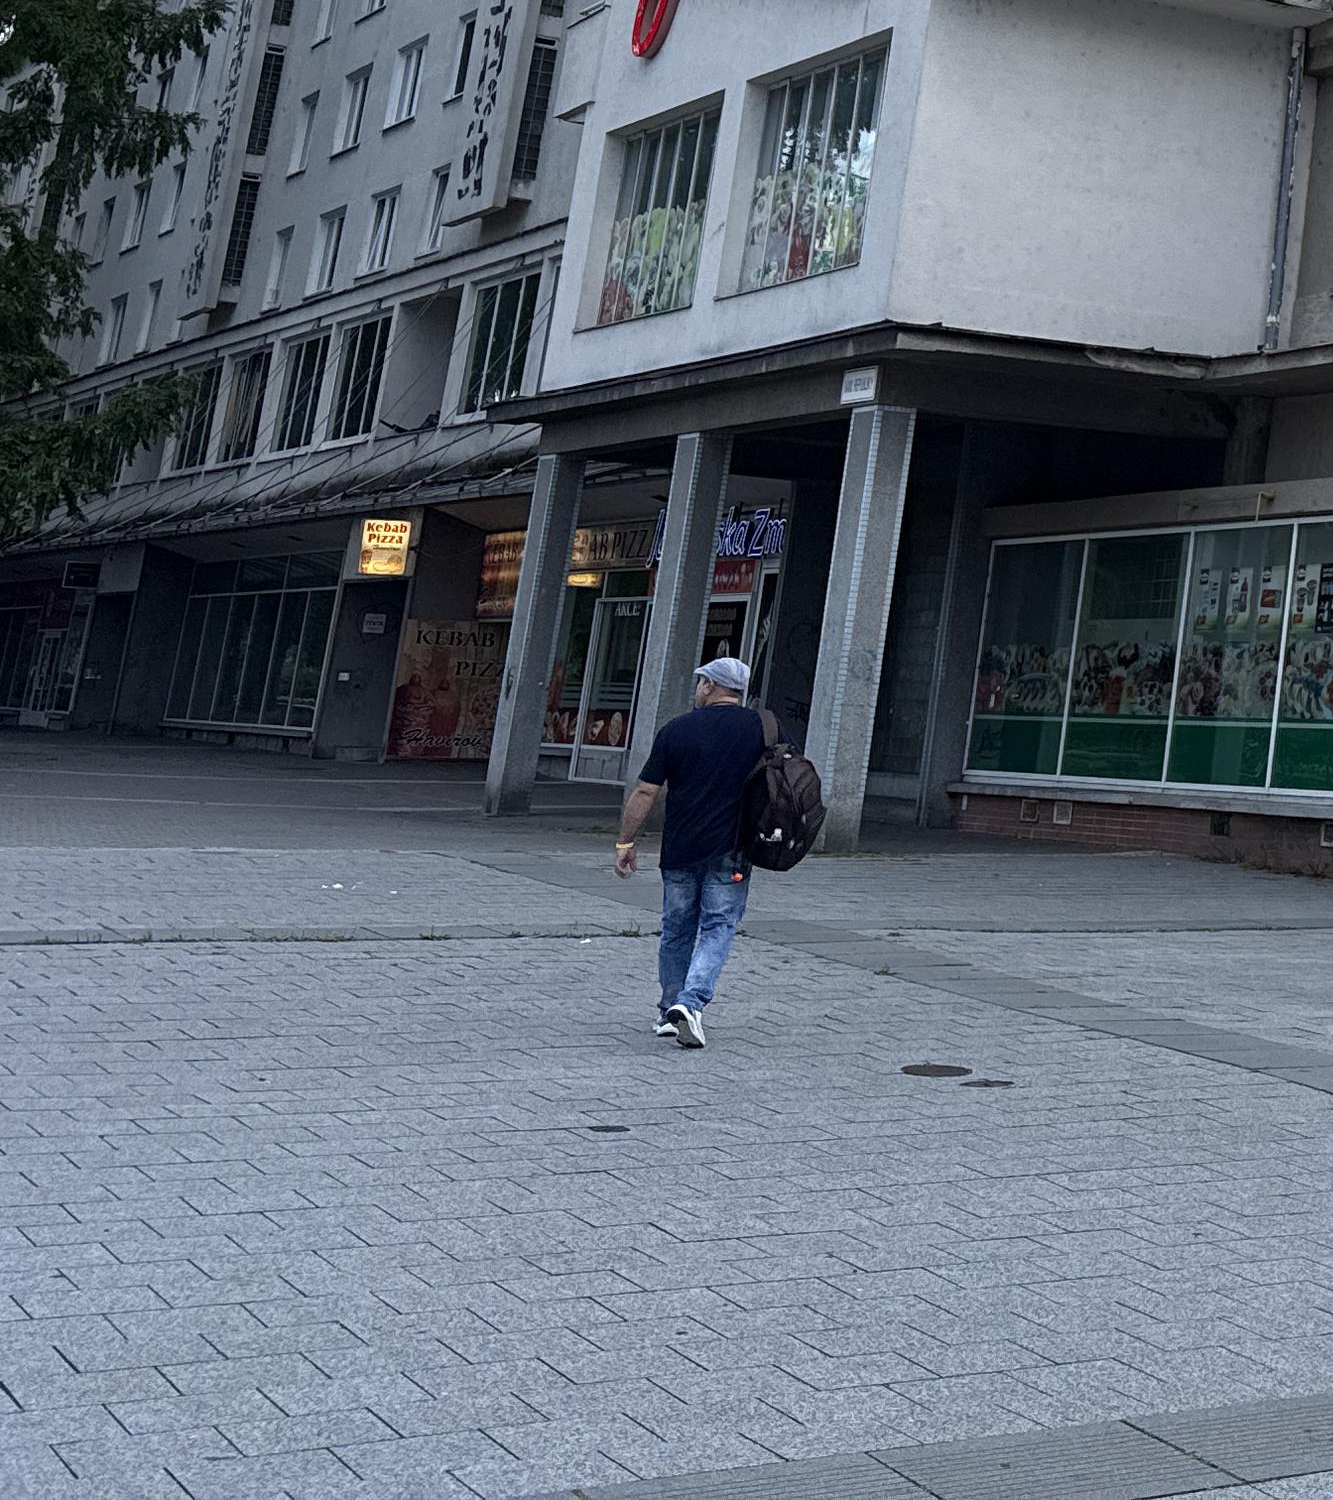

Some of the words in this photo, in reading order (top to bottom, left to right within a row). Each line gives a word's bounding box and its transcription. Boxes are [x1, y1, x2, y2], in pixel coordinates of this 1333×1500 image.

[366, 522, 408, 534] Kebab
[367, 533, 404, 545] Pizza
[610, 529, 650, 560] PIZZ
[416, 630, 496, 648] KEBAB
